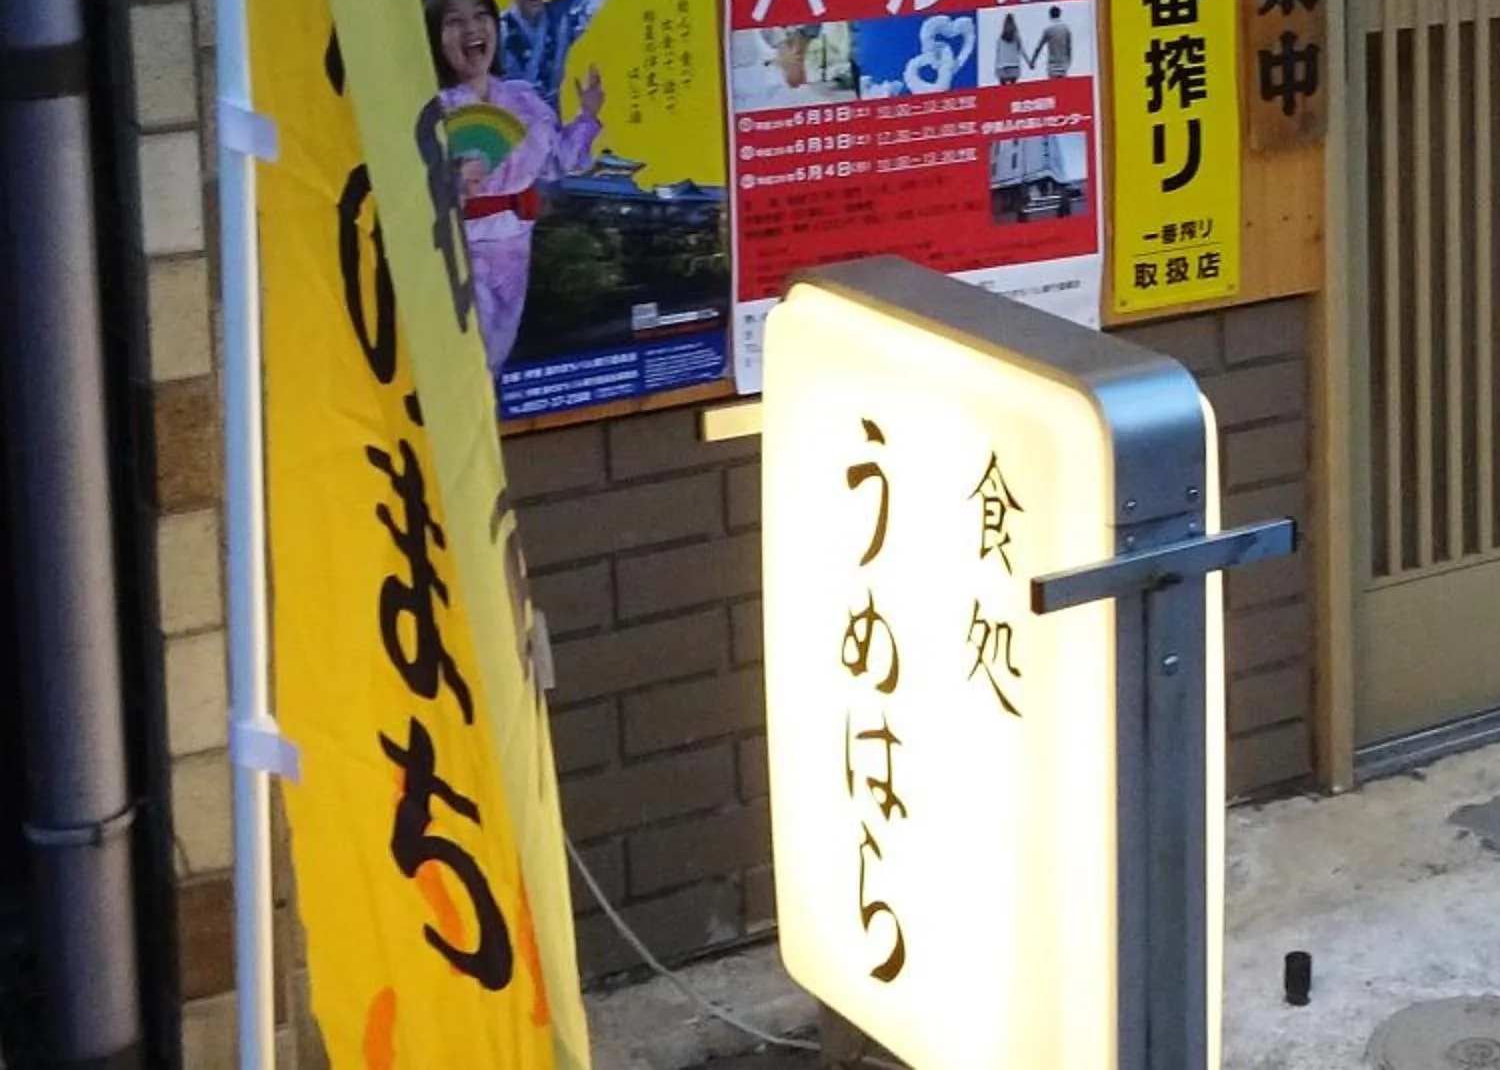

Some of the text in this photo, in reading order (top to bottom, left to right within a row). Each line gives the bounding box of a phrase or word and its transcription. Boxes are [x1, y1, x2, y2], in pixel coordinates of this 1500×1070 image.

[1133, 250, 1222, 291] 取扱店
[1142, 217, 1215, 245] 一番搾り
[962, 451, 1025, 719] 食処
[840, 417, 908, 983] うめはら
